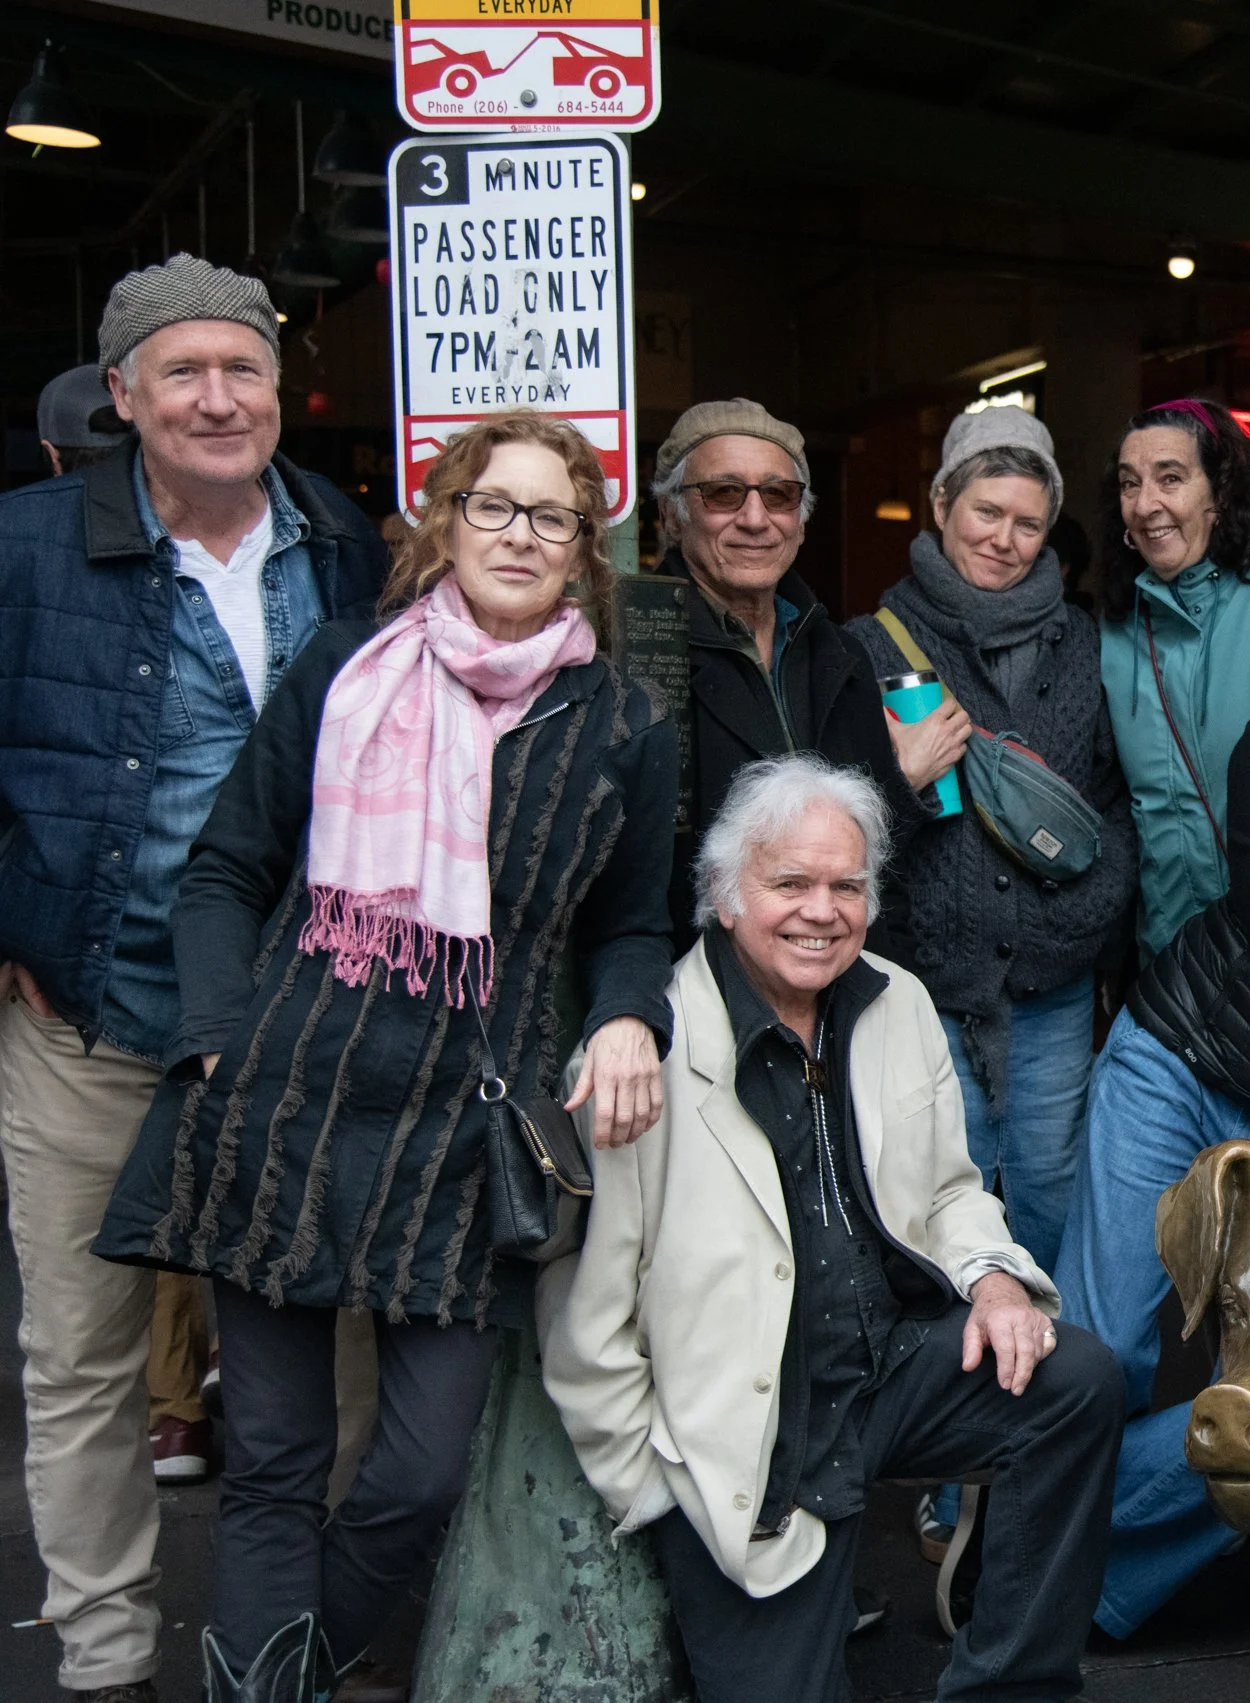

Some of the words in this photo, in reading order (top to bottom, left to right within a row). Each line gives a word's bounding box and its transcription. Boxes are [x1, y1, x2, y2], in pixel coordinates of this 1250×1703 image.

[267, 0, 395, 42] PRODUCE
[478, 0, 573, 14] EVERYDAY
[428, 101, 464, 114] Phone
[474, 100, 508, 114] (206)
[557, 101, 624, 113] 684-5444
[420, 155, 450, 197] 3
[485, 158, 604, 192] MINUTE
[414, 216, 607, 264] PASSENGER
[414, 273, 499, 318] LOAD
[524, 269, 608, 314] ONLY
[452, 384, 572, 405] EVERYDAY
[1185, 1047, 1198, 1063] 800
